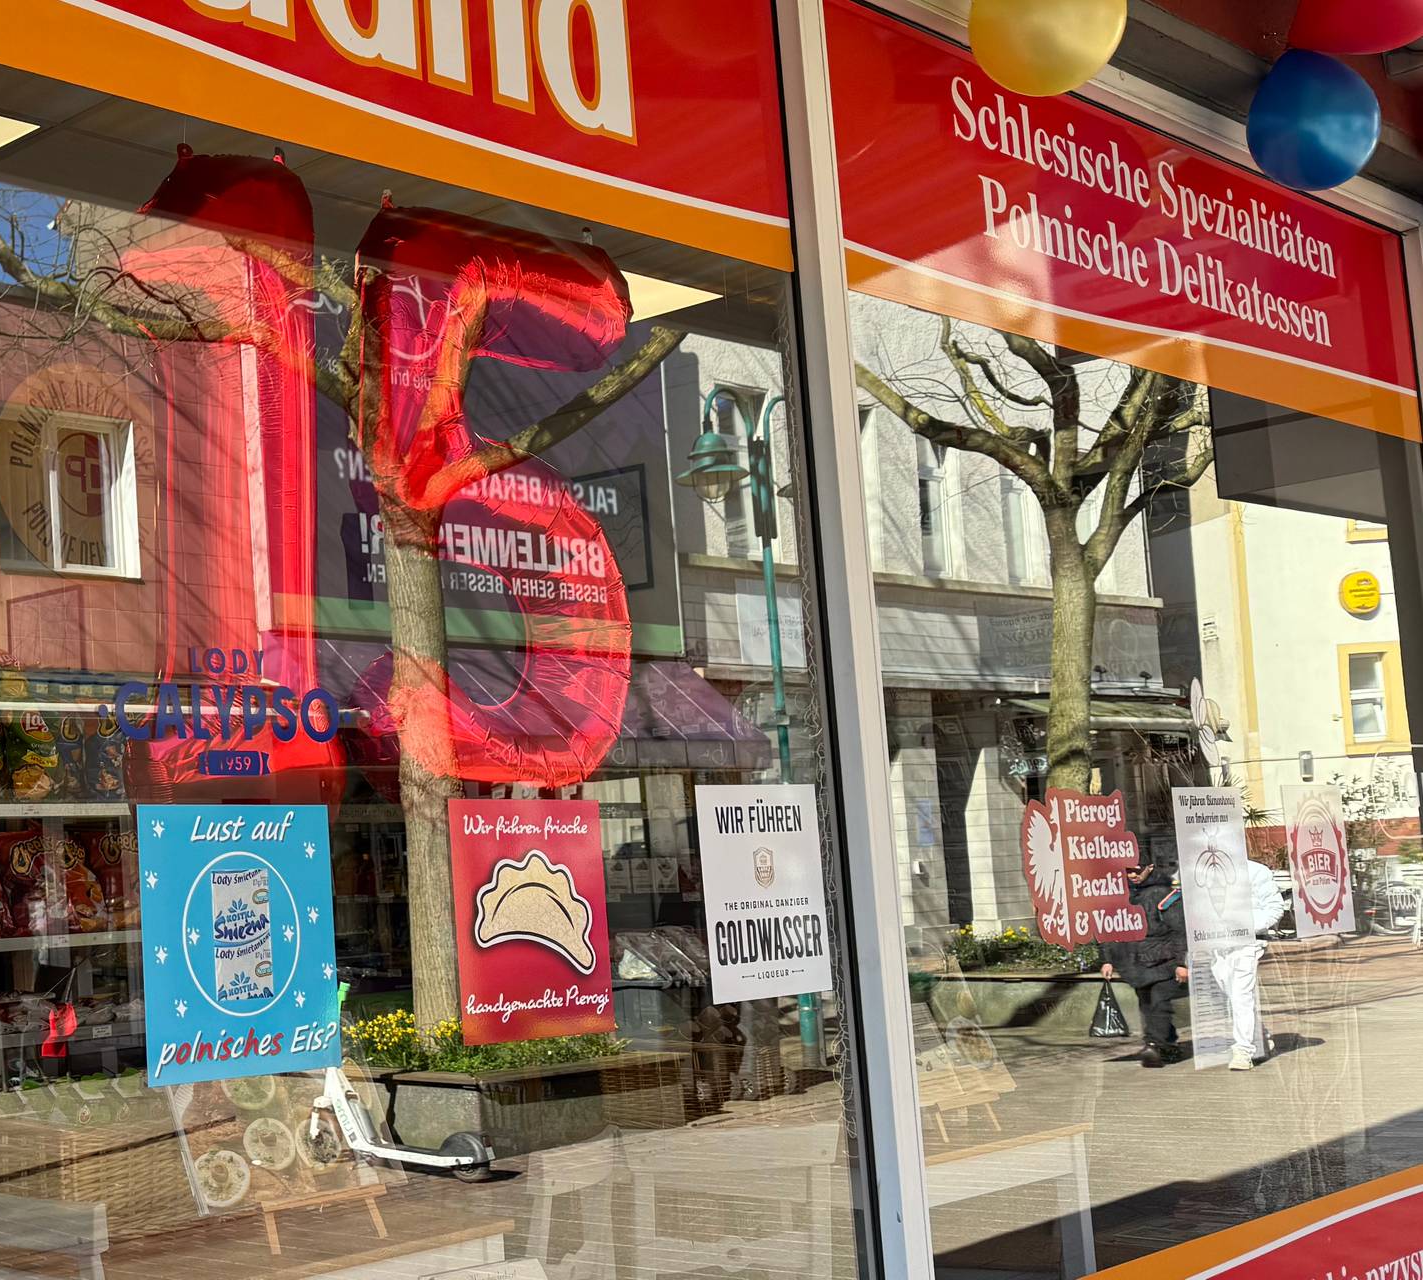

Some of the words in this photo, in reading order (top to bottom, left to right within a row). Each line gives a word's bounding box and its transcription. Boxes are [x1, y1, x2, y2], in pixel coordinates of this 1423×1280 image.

[950, 75, 1151, 208] Schlesische
[1157, 160, 1337, 279] Spezialitäten
[978, 174, 1149, 288] Polnische
[1155, 237, 1333, 347] Delikatessen
[188, 647, 264, 674] LODY
[115, 681, 339, 743] CALYPSO
[220, 756, 251, 771] 1959
[190, 815, 245, 843] Lust
[251, 810, 294, 841] auf
[715, 805, 745, 834] WIR
[749, 799, 802, 833] FÜHREN
[1063, 798, 1121, 828] Pierogi
[463, 815, 496, 834] Wir
[496, 815, 542, 840] führen
[544, 815, 588, 840] frische
[1068, 836, 1135, 860] Kielbasa
[1307, 854, 1331, 873] BIER
[1070, 872, 1125, 898] Paczki
[724, 902, 739, 911] THE
[741, 899, 773, 910] ORIGINAL
[776, 897, 809, 907] DANZIGER
[1075, 911, 1089, 936] &
[1092, 909, 1143, 934] Vodka
[715, 914, 823, 966] GOLDWASSER
[757, 969, 789, 980] LIQUEUR
[466, 994, 564, 1023] handgemachte
[565, 985, 609, 1014] Pierogi
[155, 1027, 285, 1079] polnisches
[290, 1022, 337, 1054] Eis?
